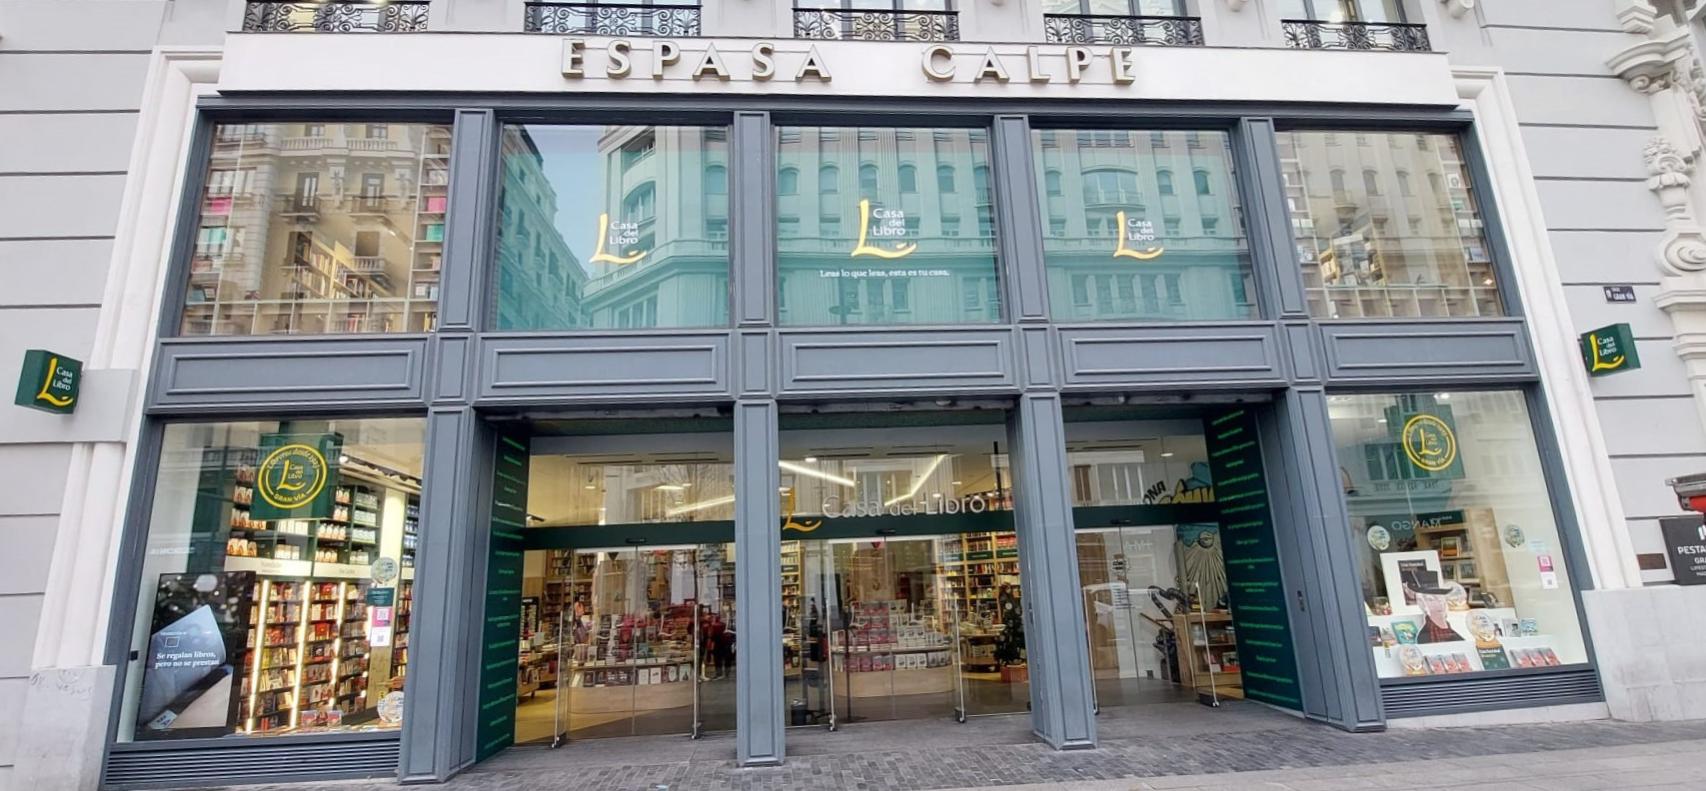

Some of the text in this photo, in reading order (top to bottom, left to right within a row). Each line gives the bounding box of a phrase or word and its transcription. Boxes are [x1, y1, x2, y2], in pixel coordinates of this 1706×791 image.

[561, 38, 1136, 86] ESPASA CALPE
[873, 208, 905, 219] Casa
[610, 220, 639, 230] Casa
[888, 218, 905, 227] del
[1127, 218, 1152, 227] Casa
[623, 229, 639, 237] del
[872, 225, 907, 236] Libro
[1140, 226, 1154, 234] del
[610, 235, 639, 245] Libro
[1128, 232, 1154, 241] Libro
[850, 270, 867, 279] que
[1597, 337, 1614, 345] Casa
[1599, 347, 1617, 356] Libro
[56, 366, 73, 378] Casa
[53, 379, 72, 391] Libro
[822, 492, 986, 518] Casa del Libro
[166, 651, 193, 661] regalan
[194, 650, 217, 658] libros,
[155, 661, 172, 670] pero
